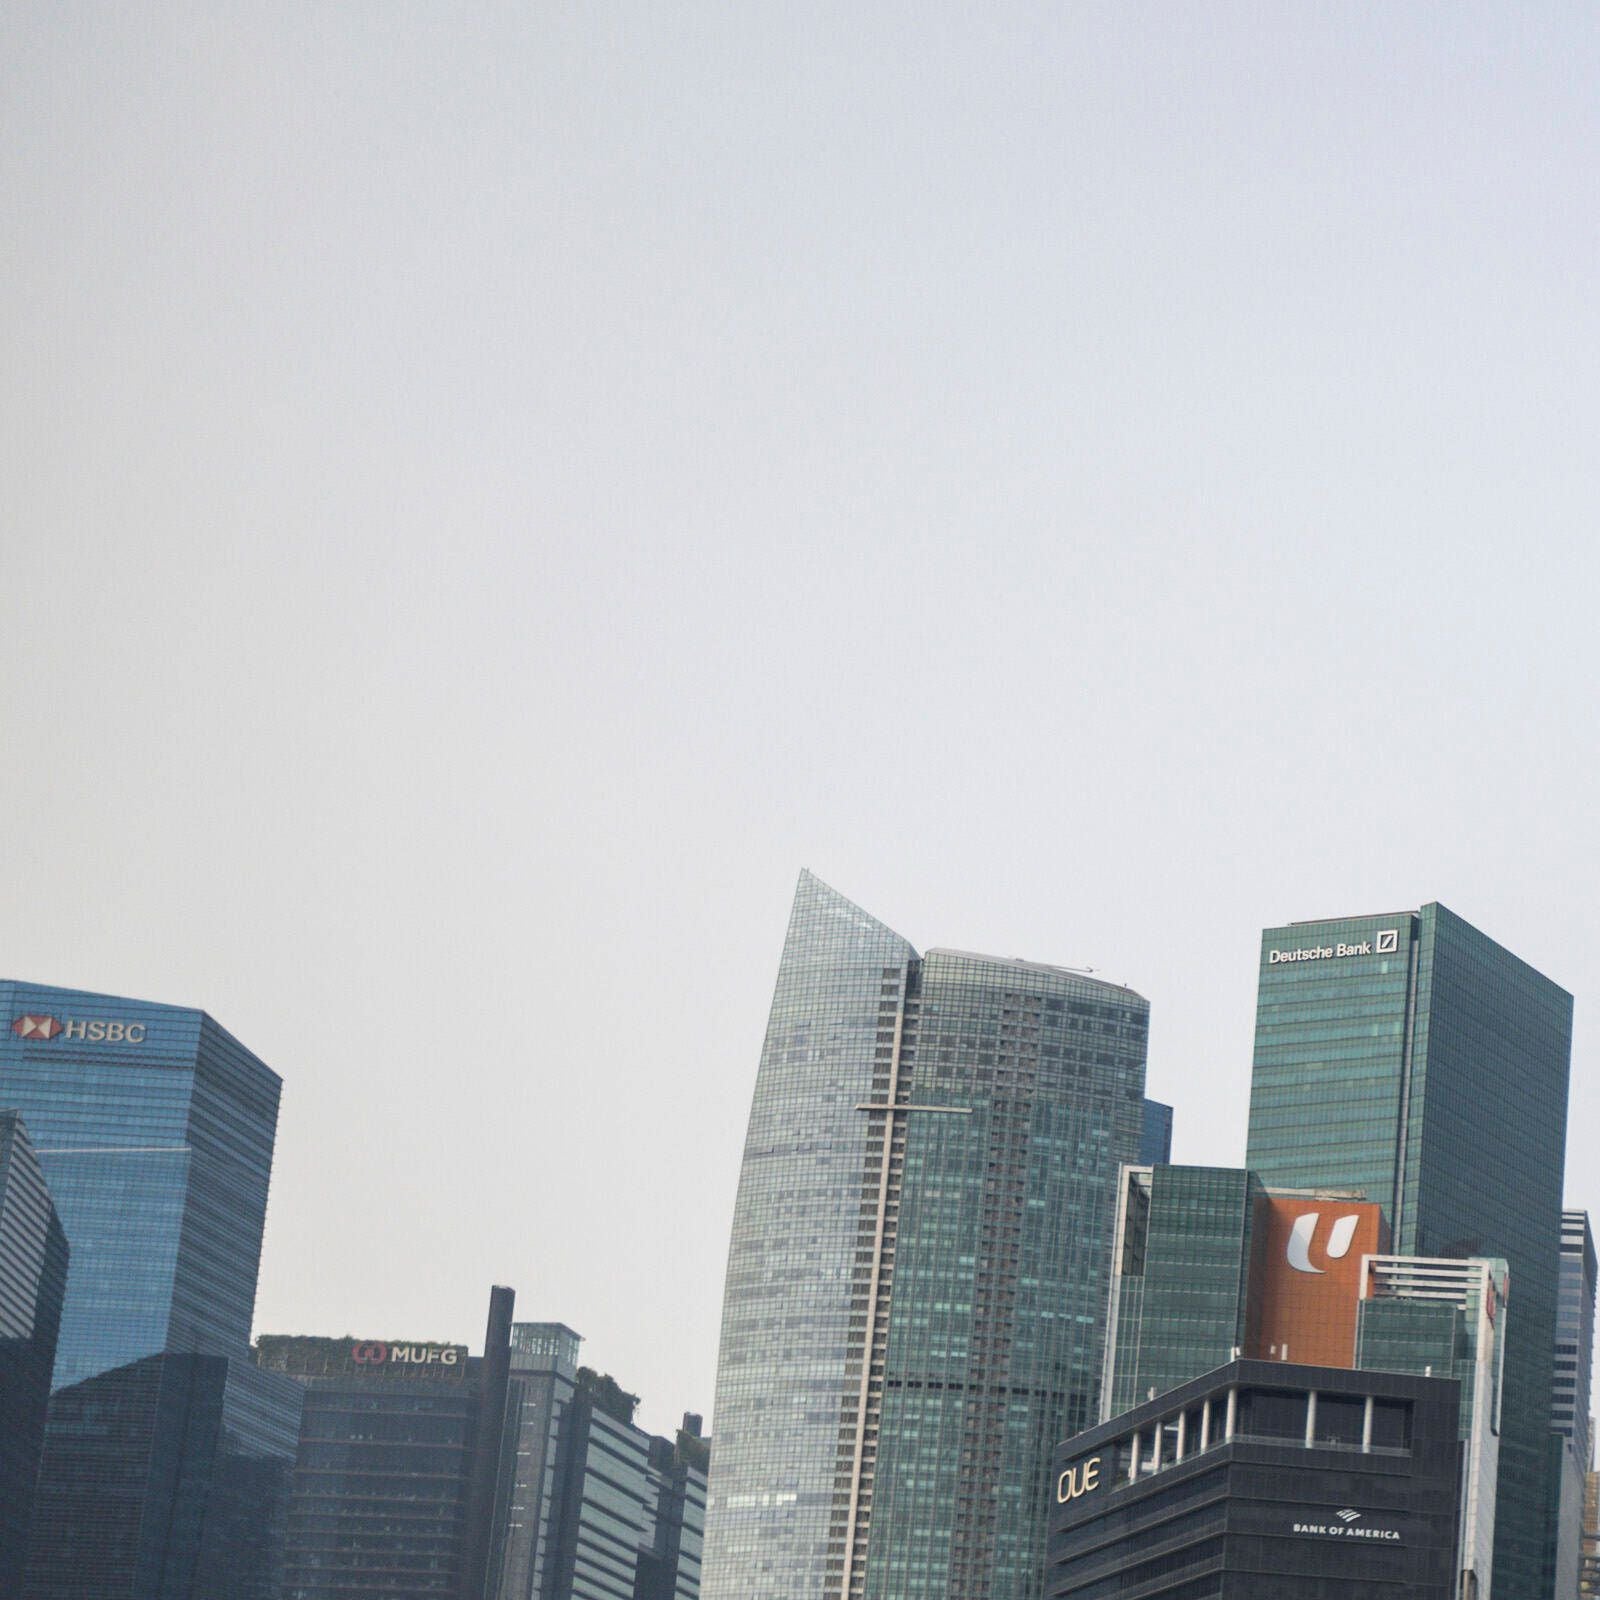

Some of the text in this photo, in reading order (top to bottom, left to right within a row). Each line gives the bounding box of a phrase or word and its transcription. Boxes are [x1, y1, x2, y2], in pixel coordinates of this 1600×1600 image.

[1269, 941, 1372, 964] Deutsche Bank
[65, 1019, 147, 1043] HSBC
[390, 1346, 458, 1366] MUFG
[1057, 1457, 1101, 1504] OUE
[1293, 1523, 1400, 1540] BANK OF AMERICA
